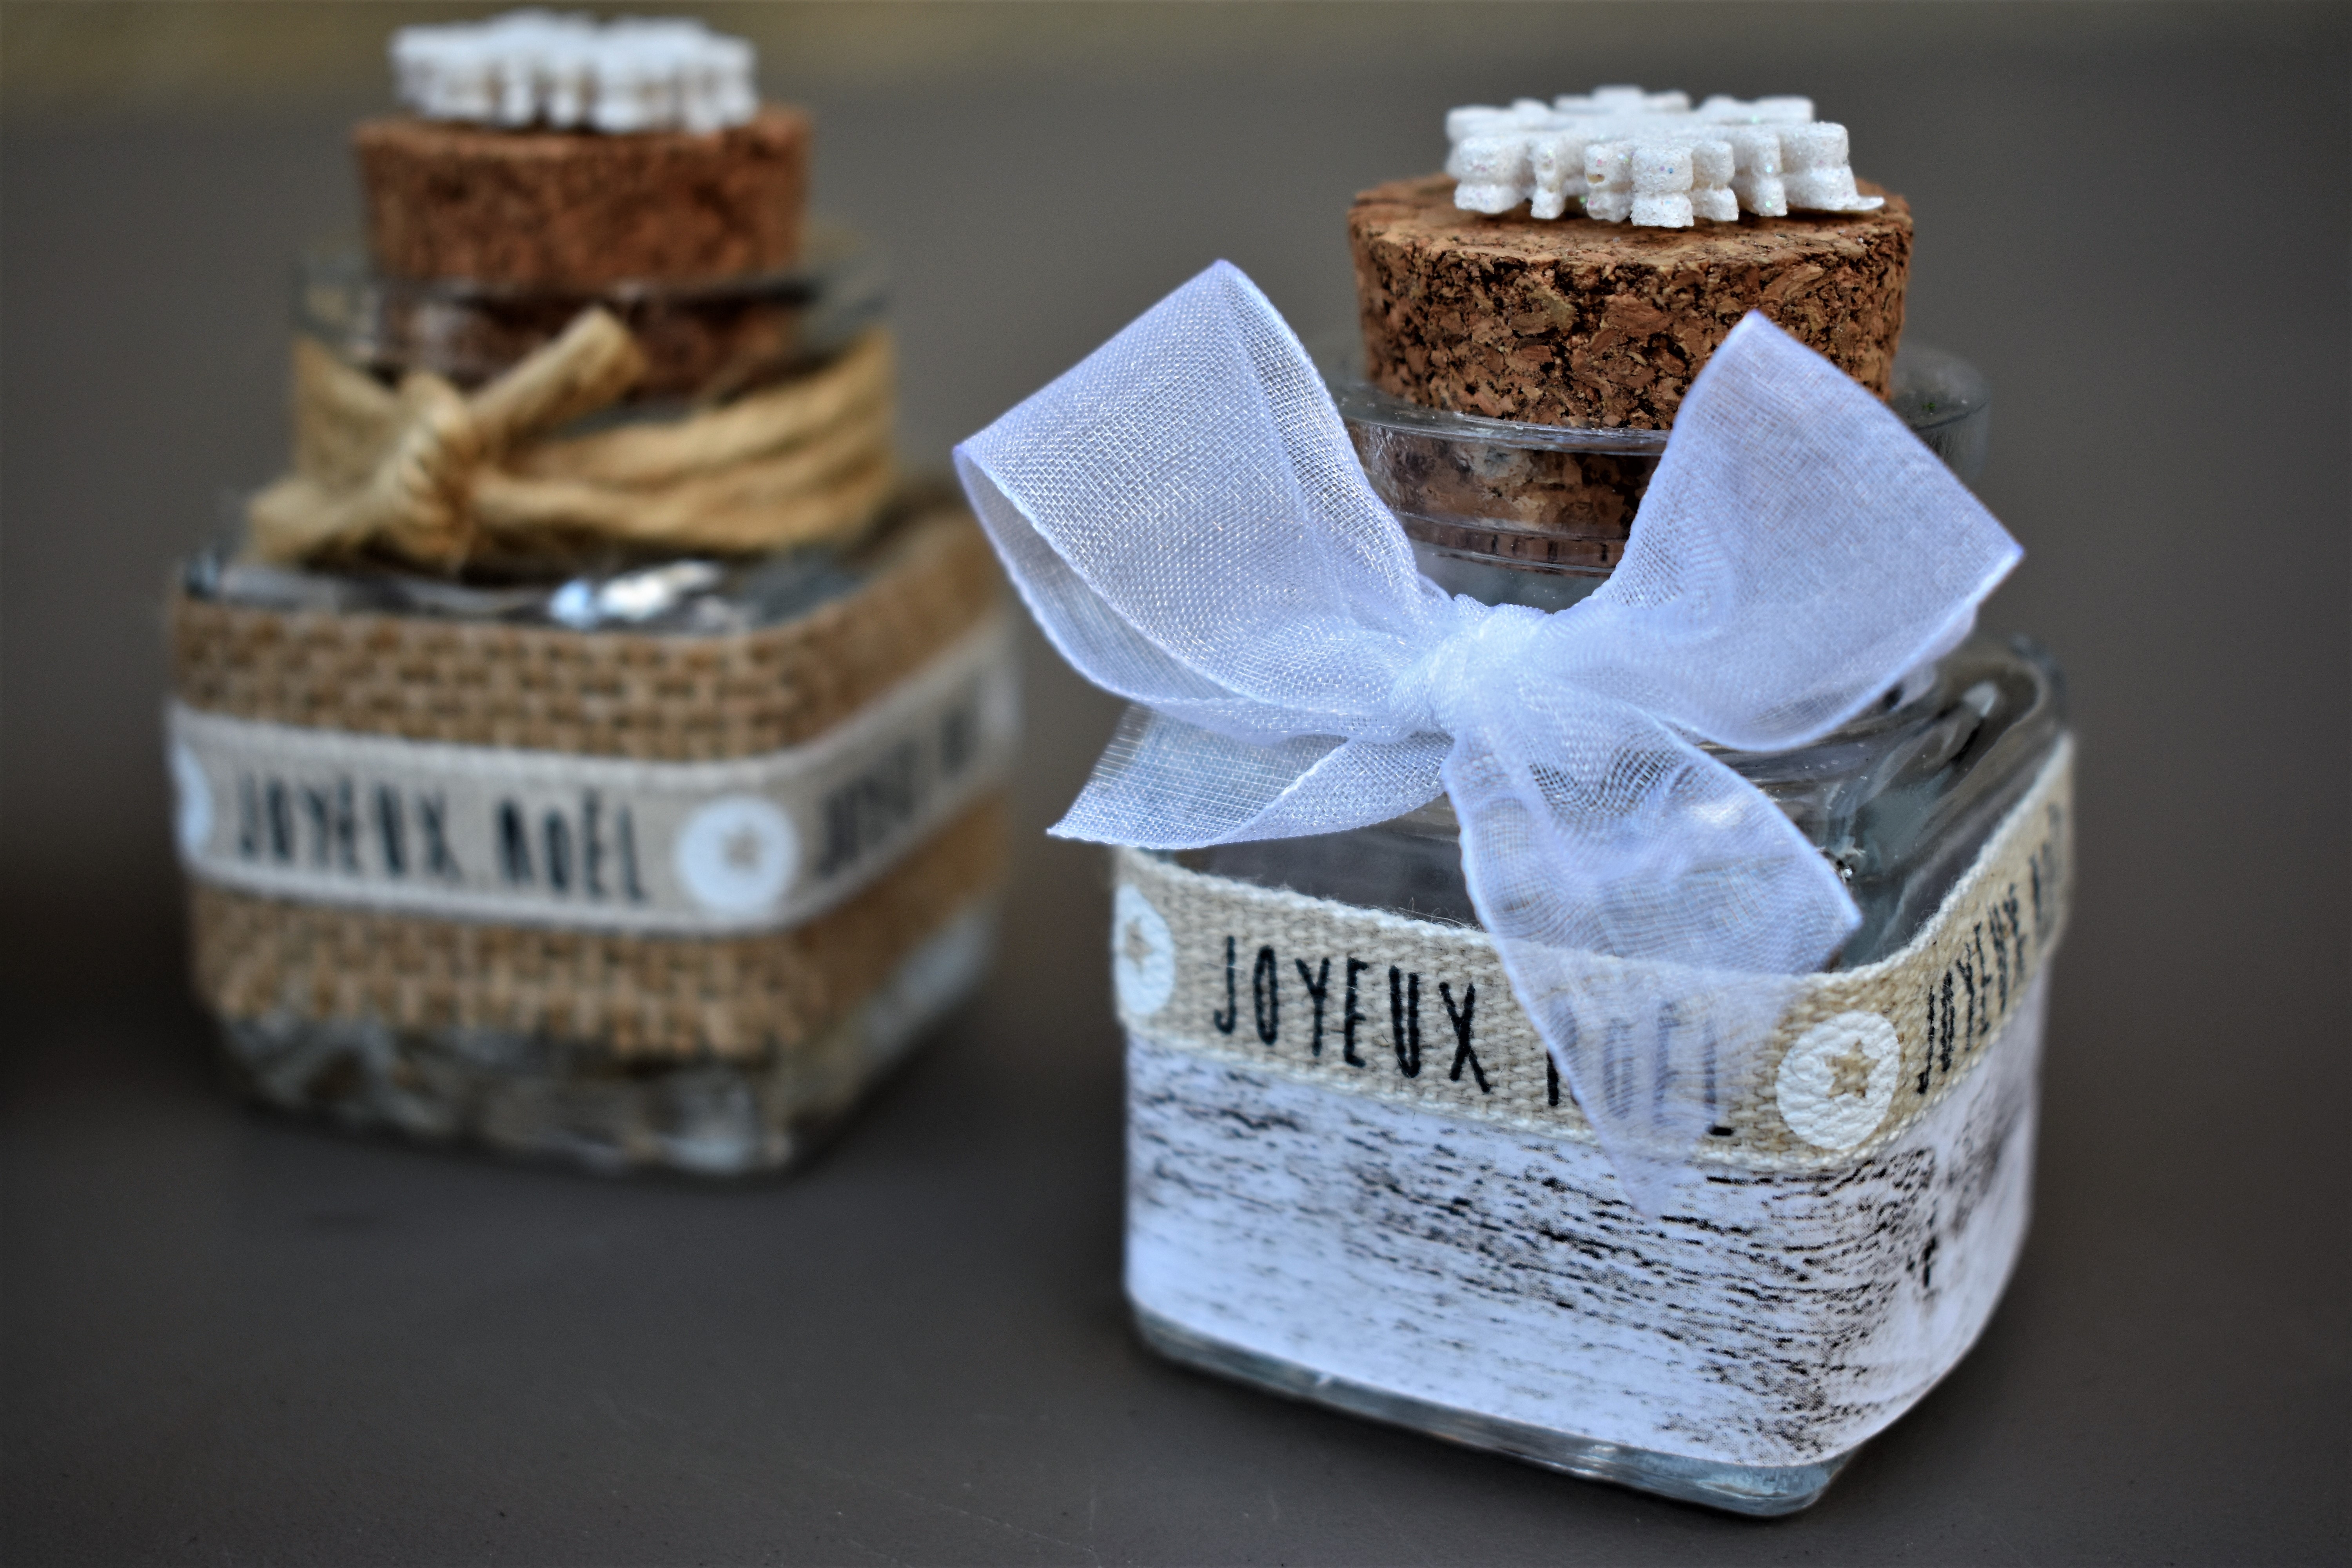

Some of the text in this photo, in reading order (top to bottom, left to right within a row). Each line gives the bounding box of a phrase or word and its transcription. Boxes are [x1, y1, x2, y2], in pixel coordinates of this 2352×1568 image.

[237, 772, 466, 880] JOYEUX
[1214, 935, 1492, 1094] JOYEUX
[1916, 882, 2027, 1095] JOYEUX
